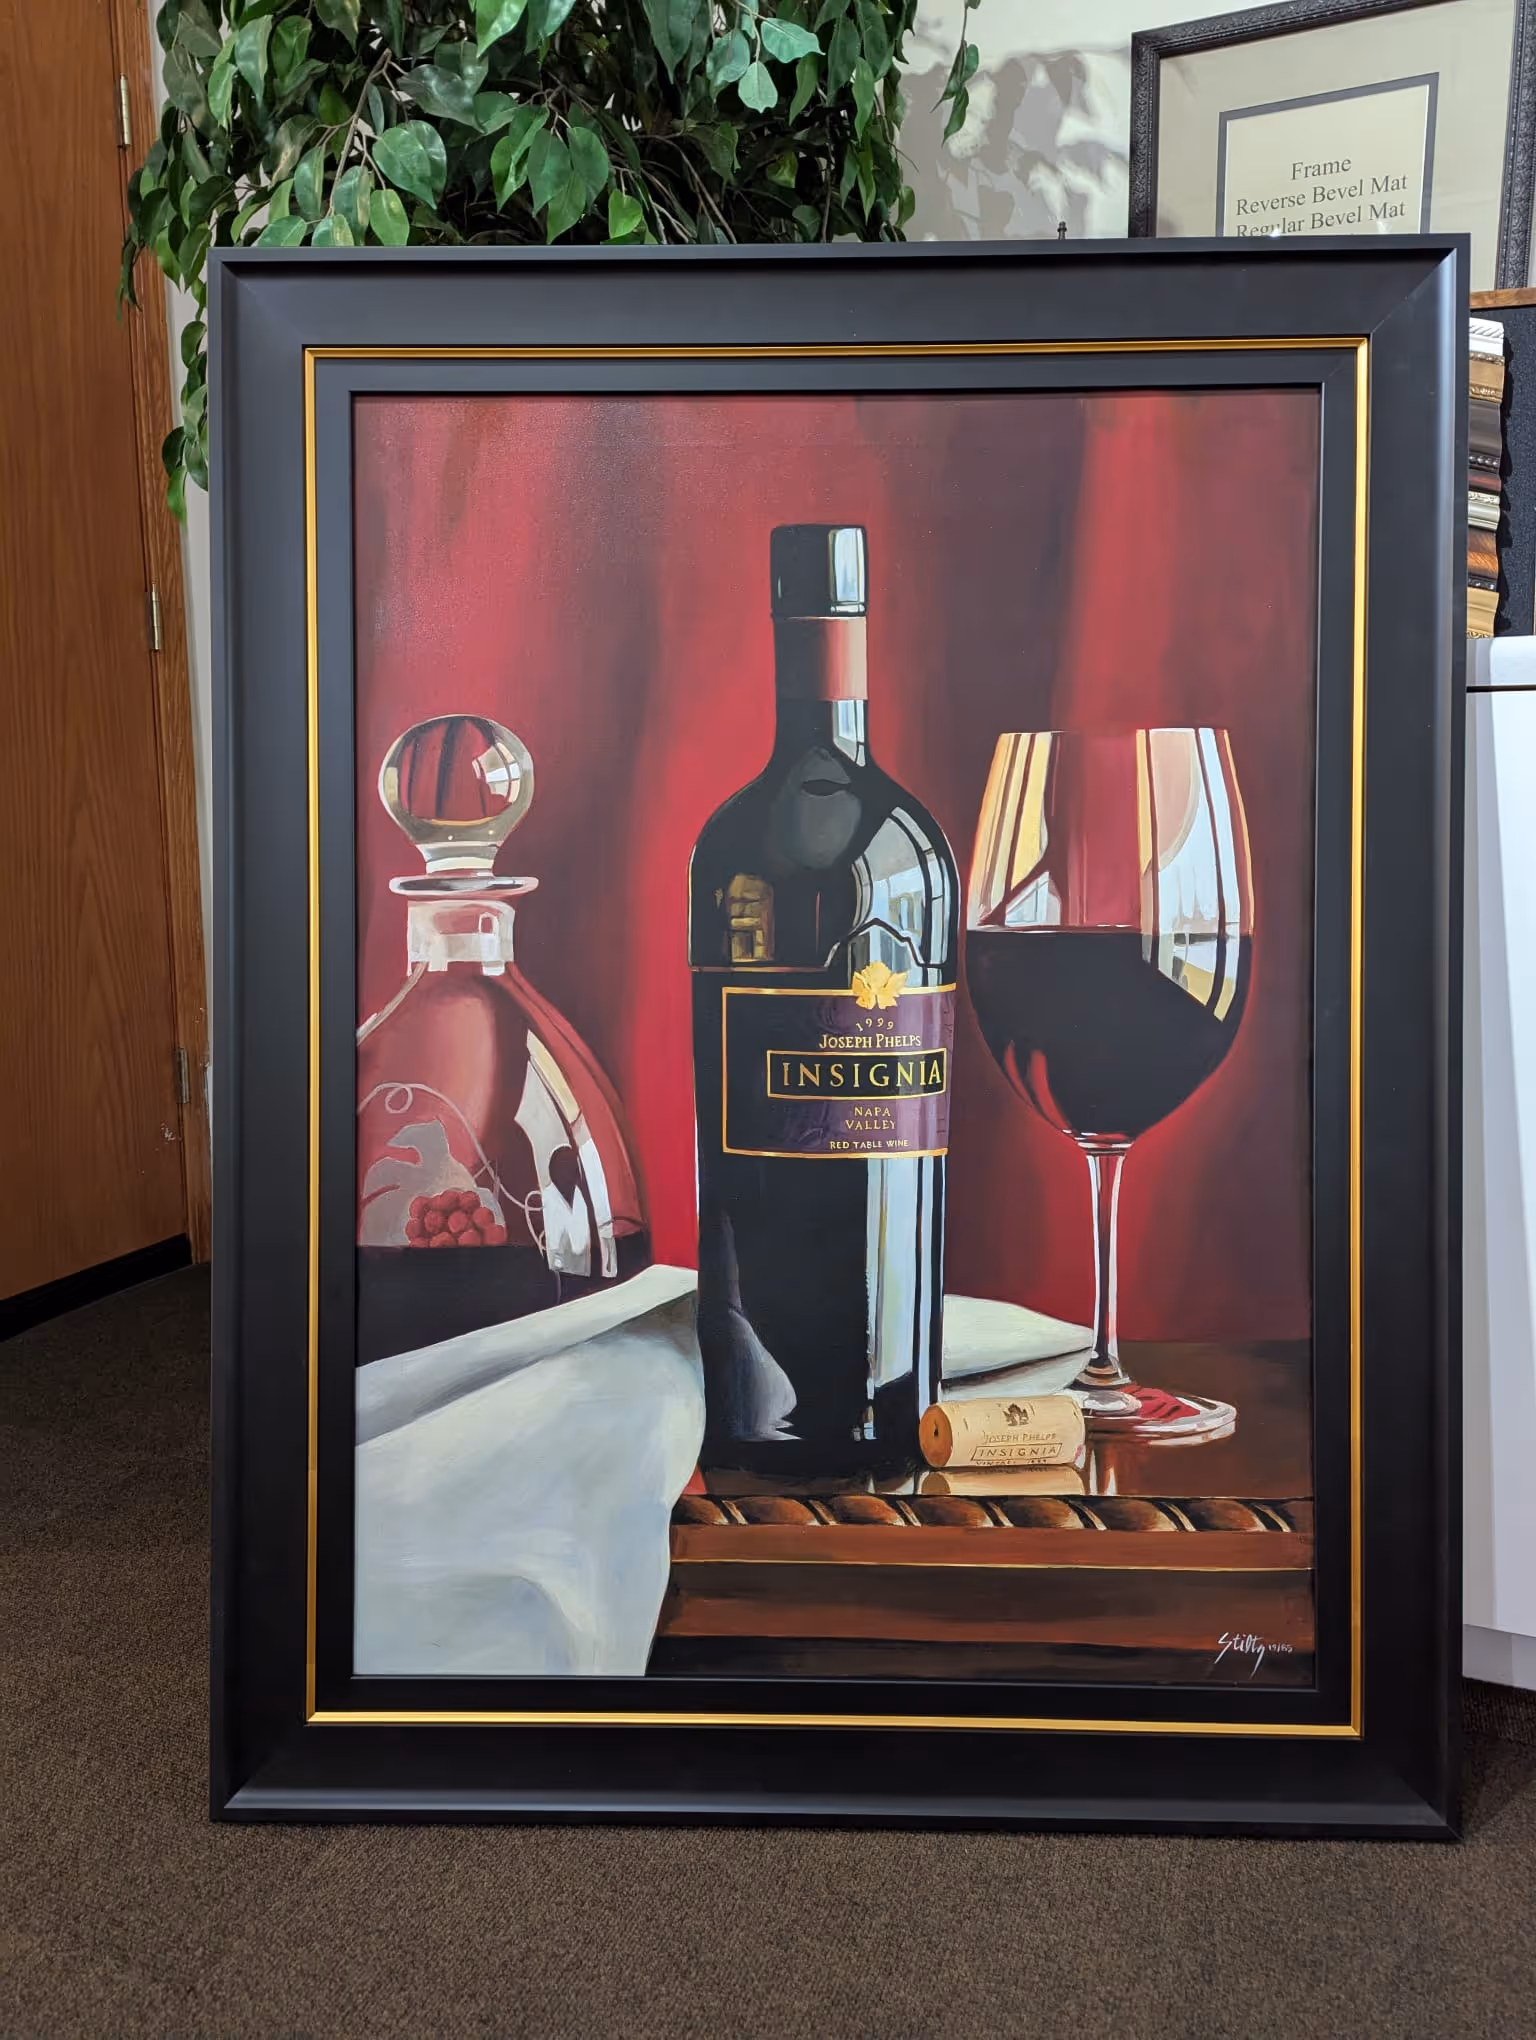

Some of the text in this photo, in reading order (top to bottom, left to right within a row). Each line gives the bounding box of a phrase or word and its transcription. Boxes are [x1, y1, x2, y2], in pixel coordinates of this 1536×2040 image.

[1291, 158, 1352, 180] Frame
[1236, 175, 1408, 215] Reverse Bevel Mat
[1311, 206, 1362, 229] Bevel
[1369, 202, 1406, 221] Mat
[855, 1018, 894, 1032] 1999
[782, 1060, 942, 1088] INSIGNIA
[854, 1107, 891, 1117] NAPA
[845, 1120, 896, 1130] VALLEY
[830, 1139, 908, 1149] RED TABLE WINE
[1023, 1433, 1057, 1441] PHELPS
[980, 1446, 1056, 1457] INSIGNIA
